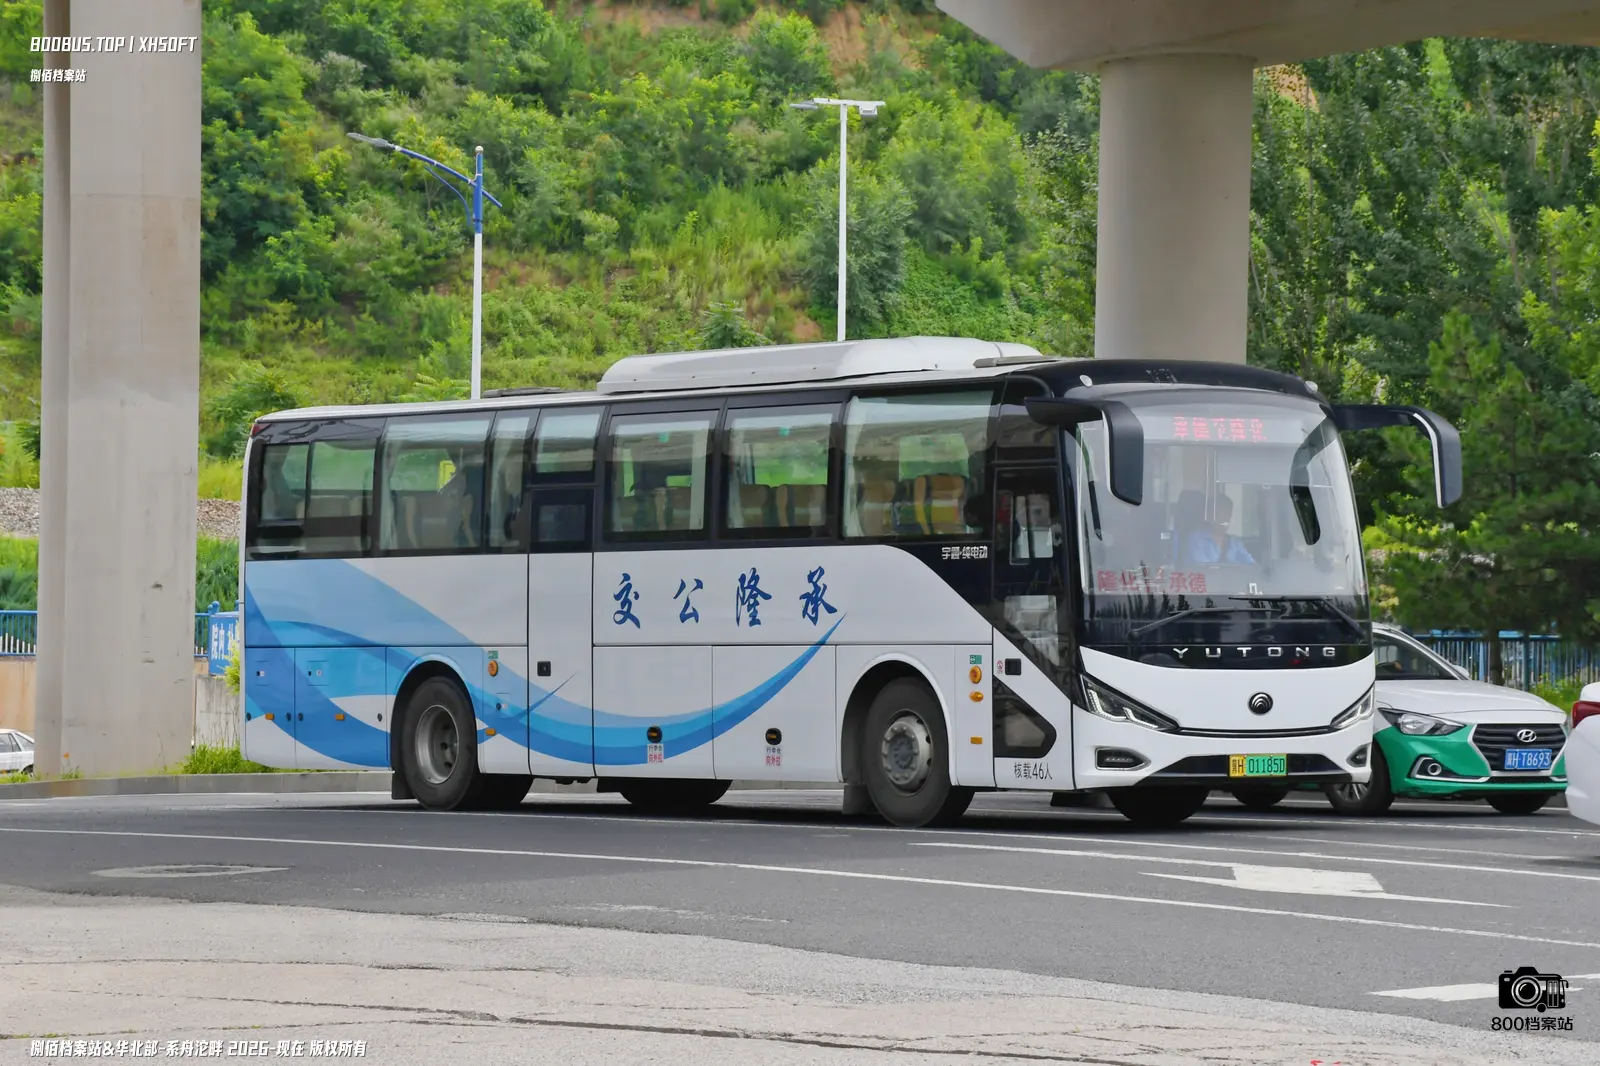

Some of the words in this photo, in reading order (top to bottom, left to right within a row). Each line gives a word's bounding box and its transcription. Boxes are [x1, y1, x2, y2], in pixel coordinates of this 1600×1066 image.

[1173, 646, 1336, 659] YUTONG
[1014, 761, 1053, 780] 核载46人
